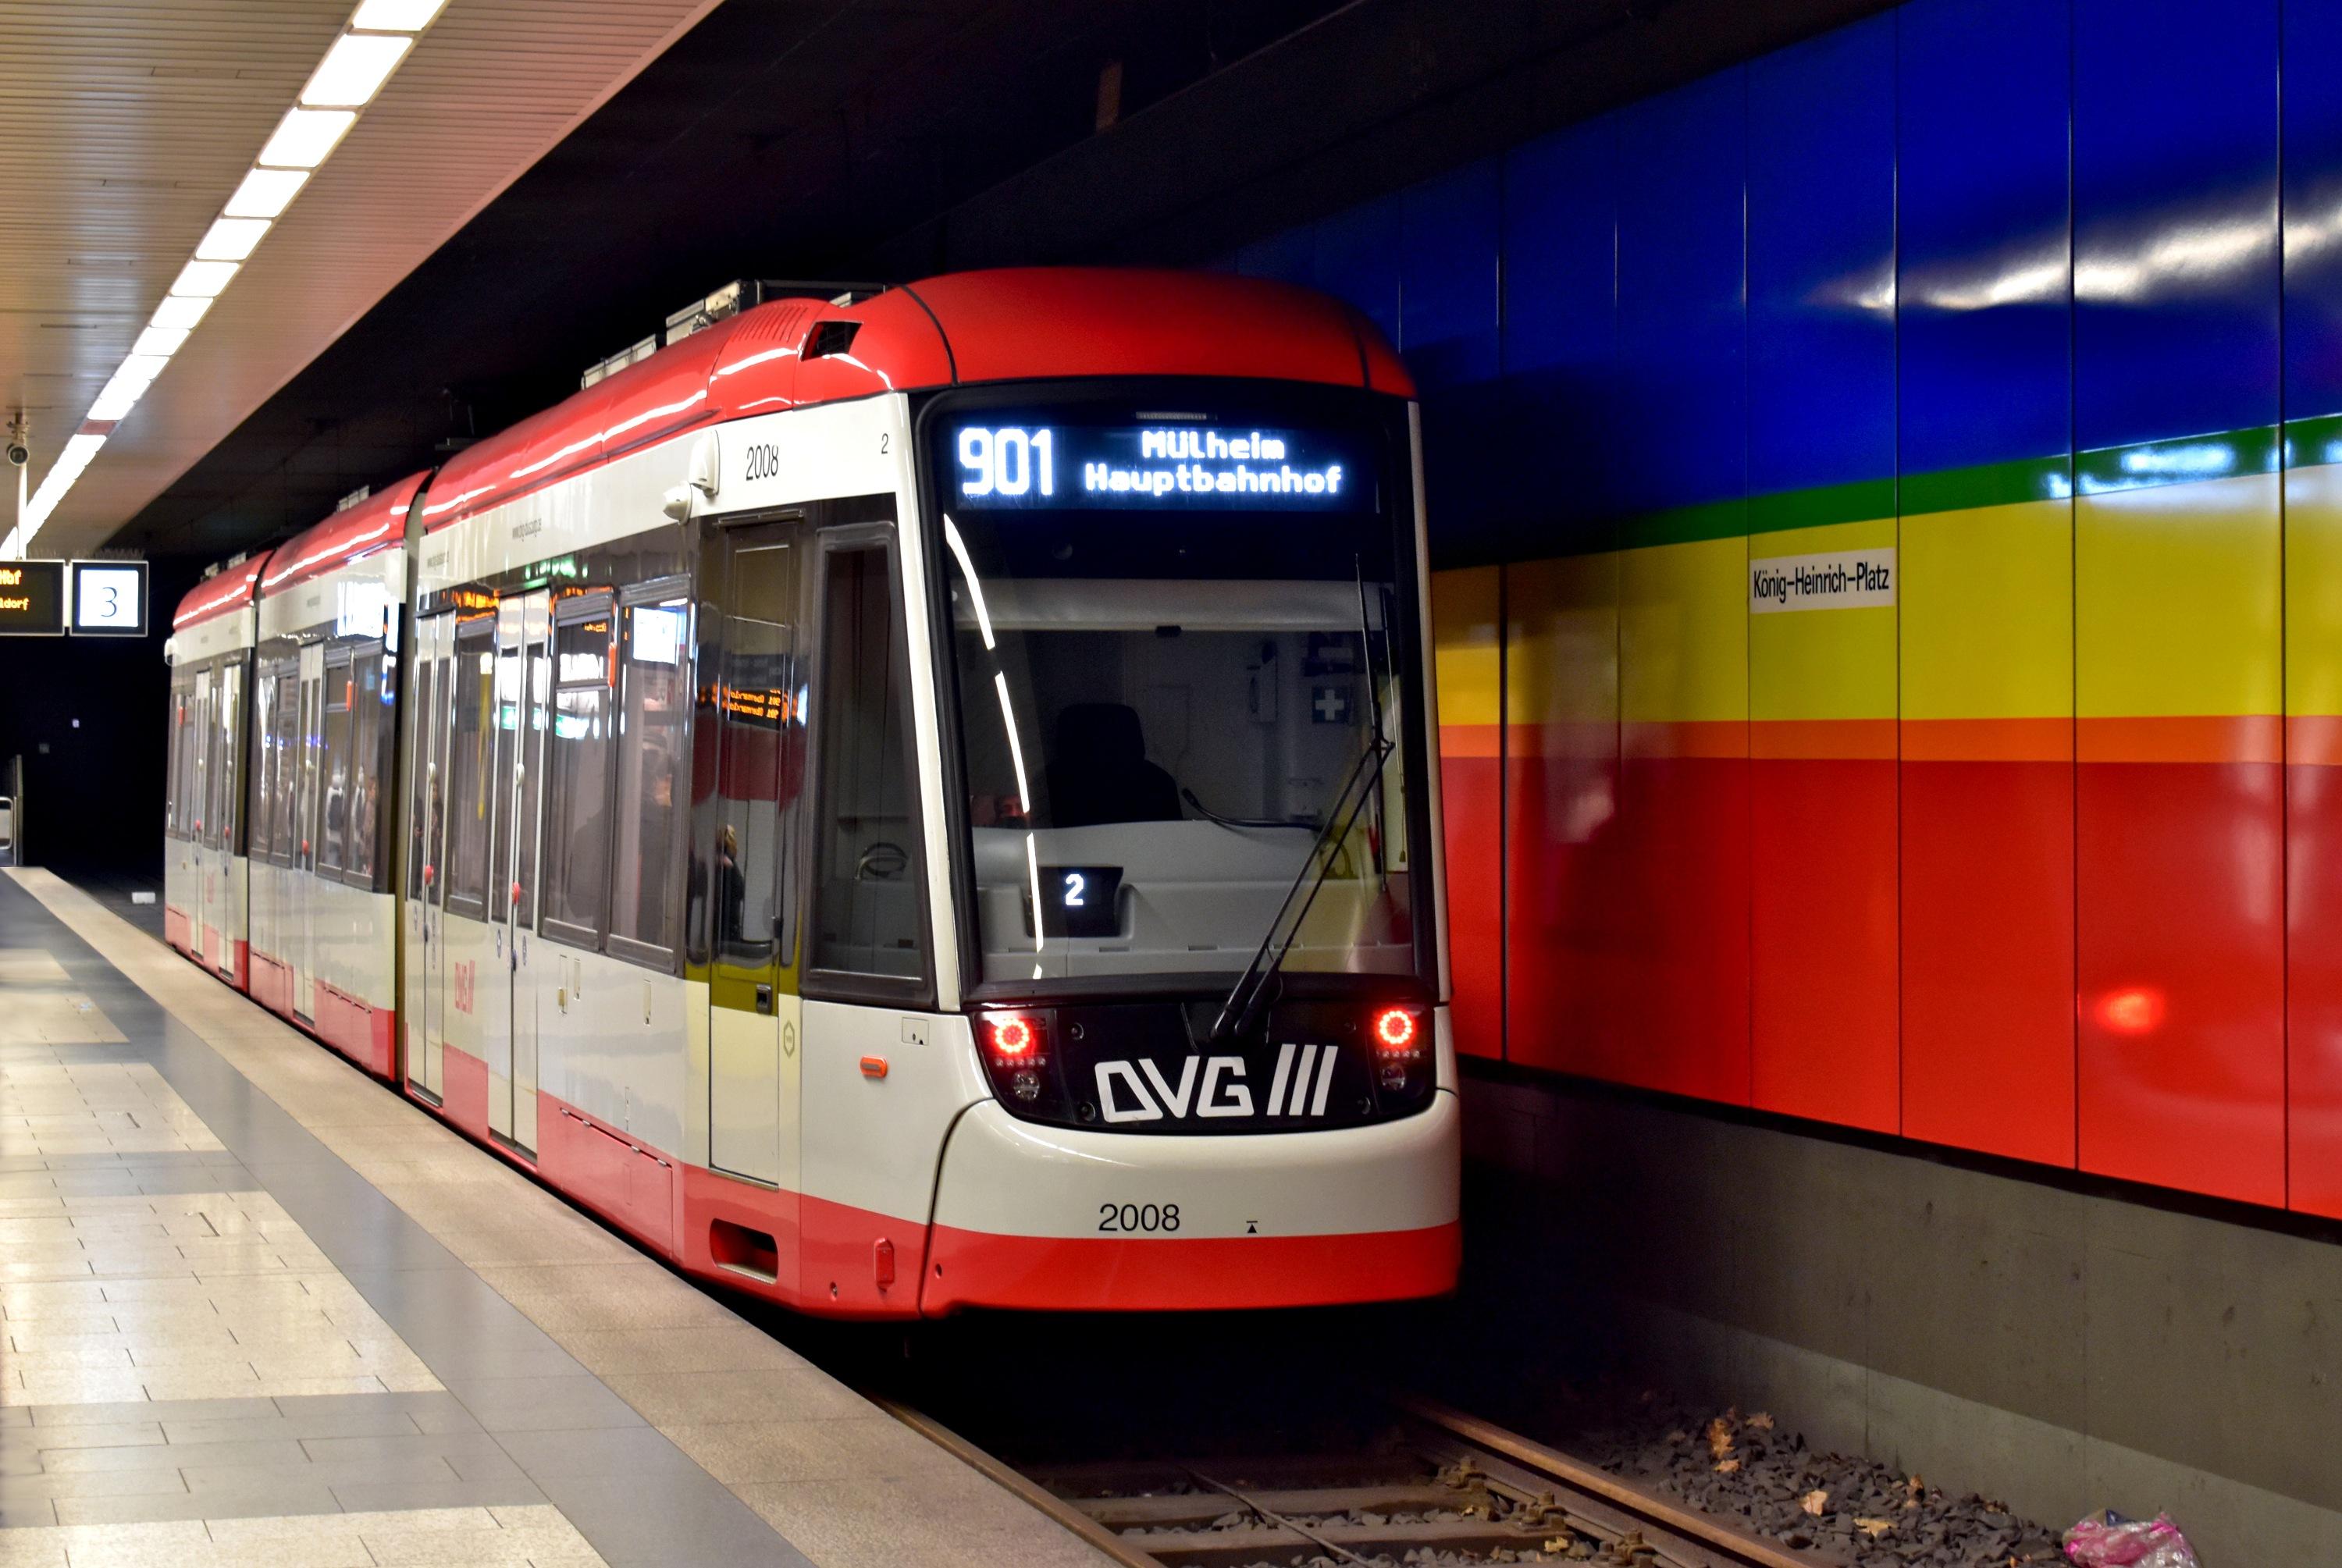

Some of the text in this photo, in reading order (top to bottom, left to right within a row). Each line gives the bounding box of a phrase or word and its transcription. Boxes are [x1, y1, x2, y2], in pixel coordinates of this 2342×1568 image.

[881, 433, 888, 454] 2
[1141, 430, 1285, 459] Mülheim
[746, 443, 779, 481] 2008
[959, 427, 1054, 498] 901
[1084, 462, 1342, 496] Hauptbahnhof
[1753, 561, 1889, 604] König-Heinrich-Platz
[100, 586, 119, 617] 3
[1065, 873, 1084, 906] 2
[1094, 1055, 1255, 1123] DVG
[1098, 1203, 1180, 1232] 2008
